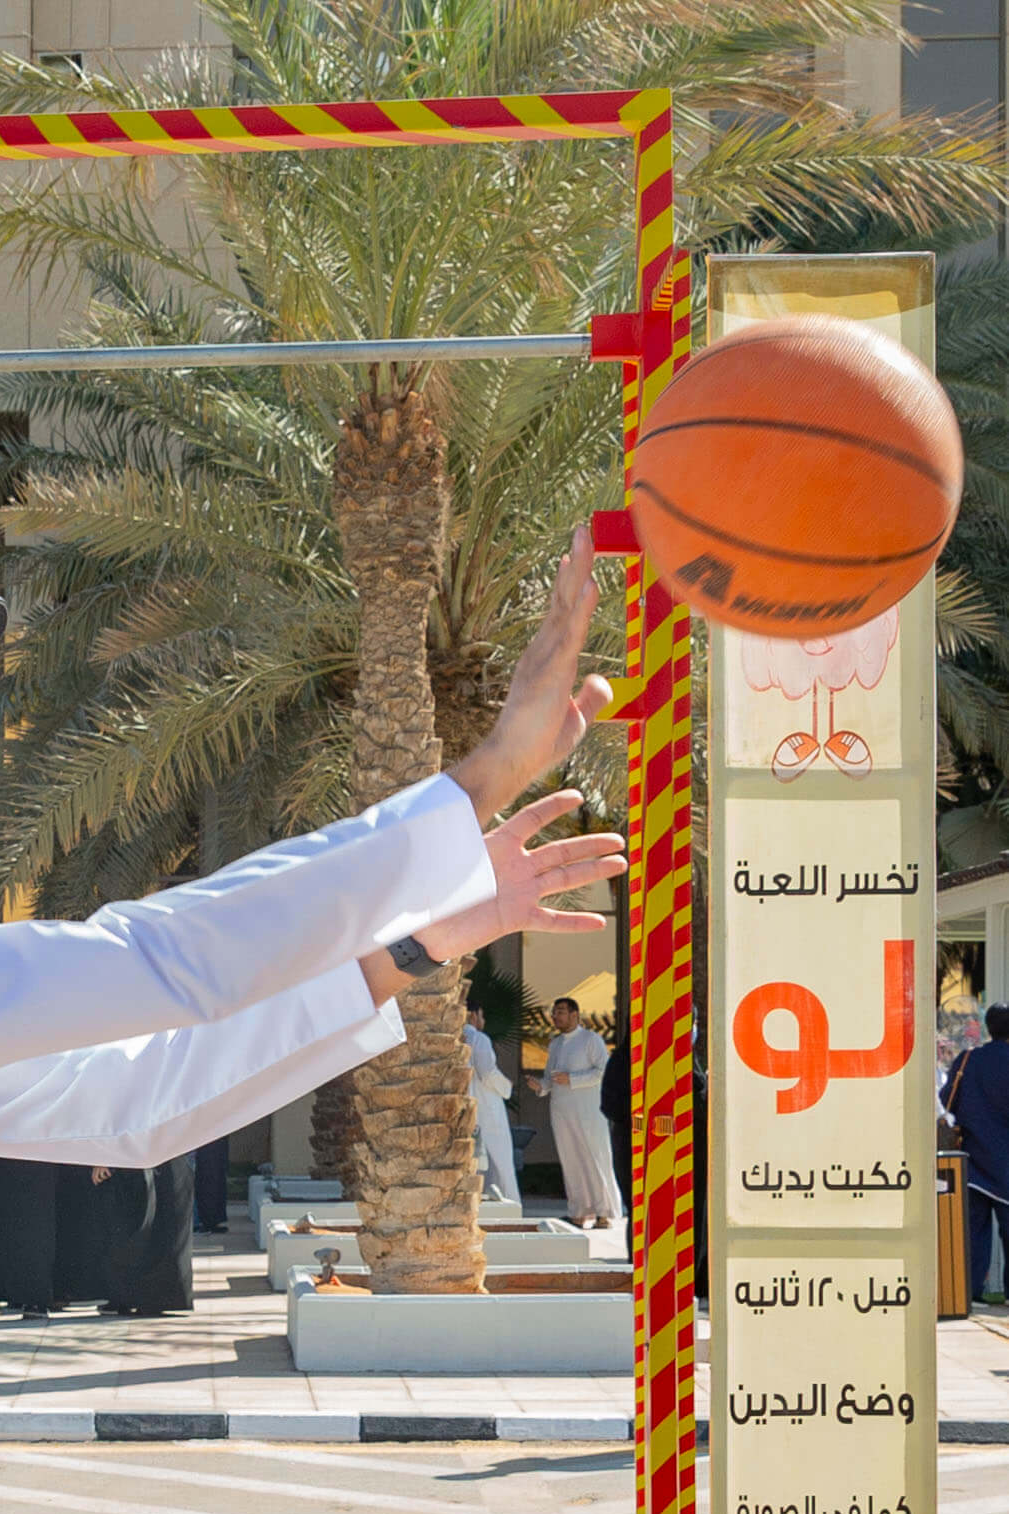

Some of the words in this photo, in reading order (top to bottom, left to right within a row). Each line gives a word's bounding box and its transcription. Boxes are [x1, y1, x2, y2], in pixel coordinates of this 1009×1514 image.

[734, 861, 827, 904] اللعبة
[836, 863, 919, 903] تخسر
[733, 939, 915, 1114] لو
[742, 1162, 814, 1199] يديك
[822, 1161, 911, 1199] فكيت
[735, 1270, 800, 1315] ثانيه
[854, 1276, 911, 1314] قبل
[729, 1384, 827, 1425] اليدين
[836, 1383, 915, 1425] وضع
